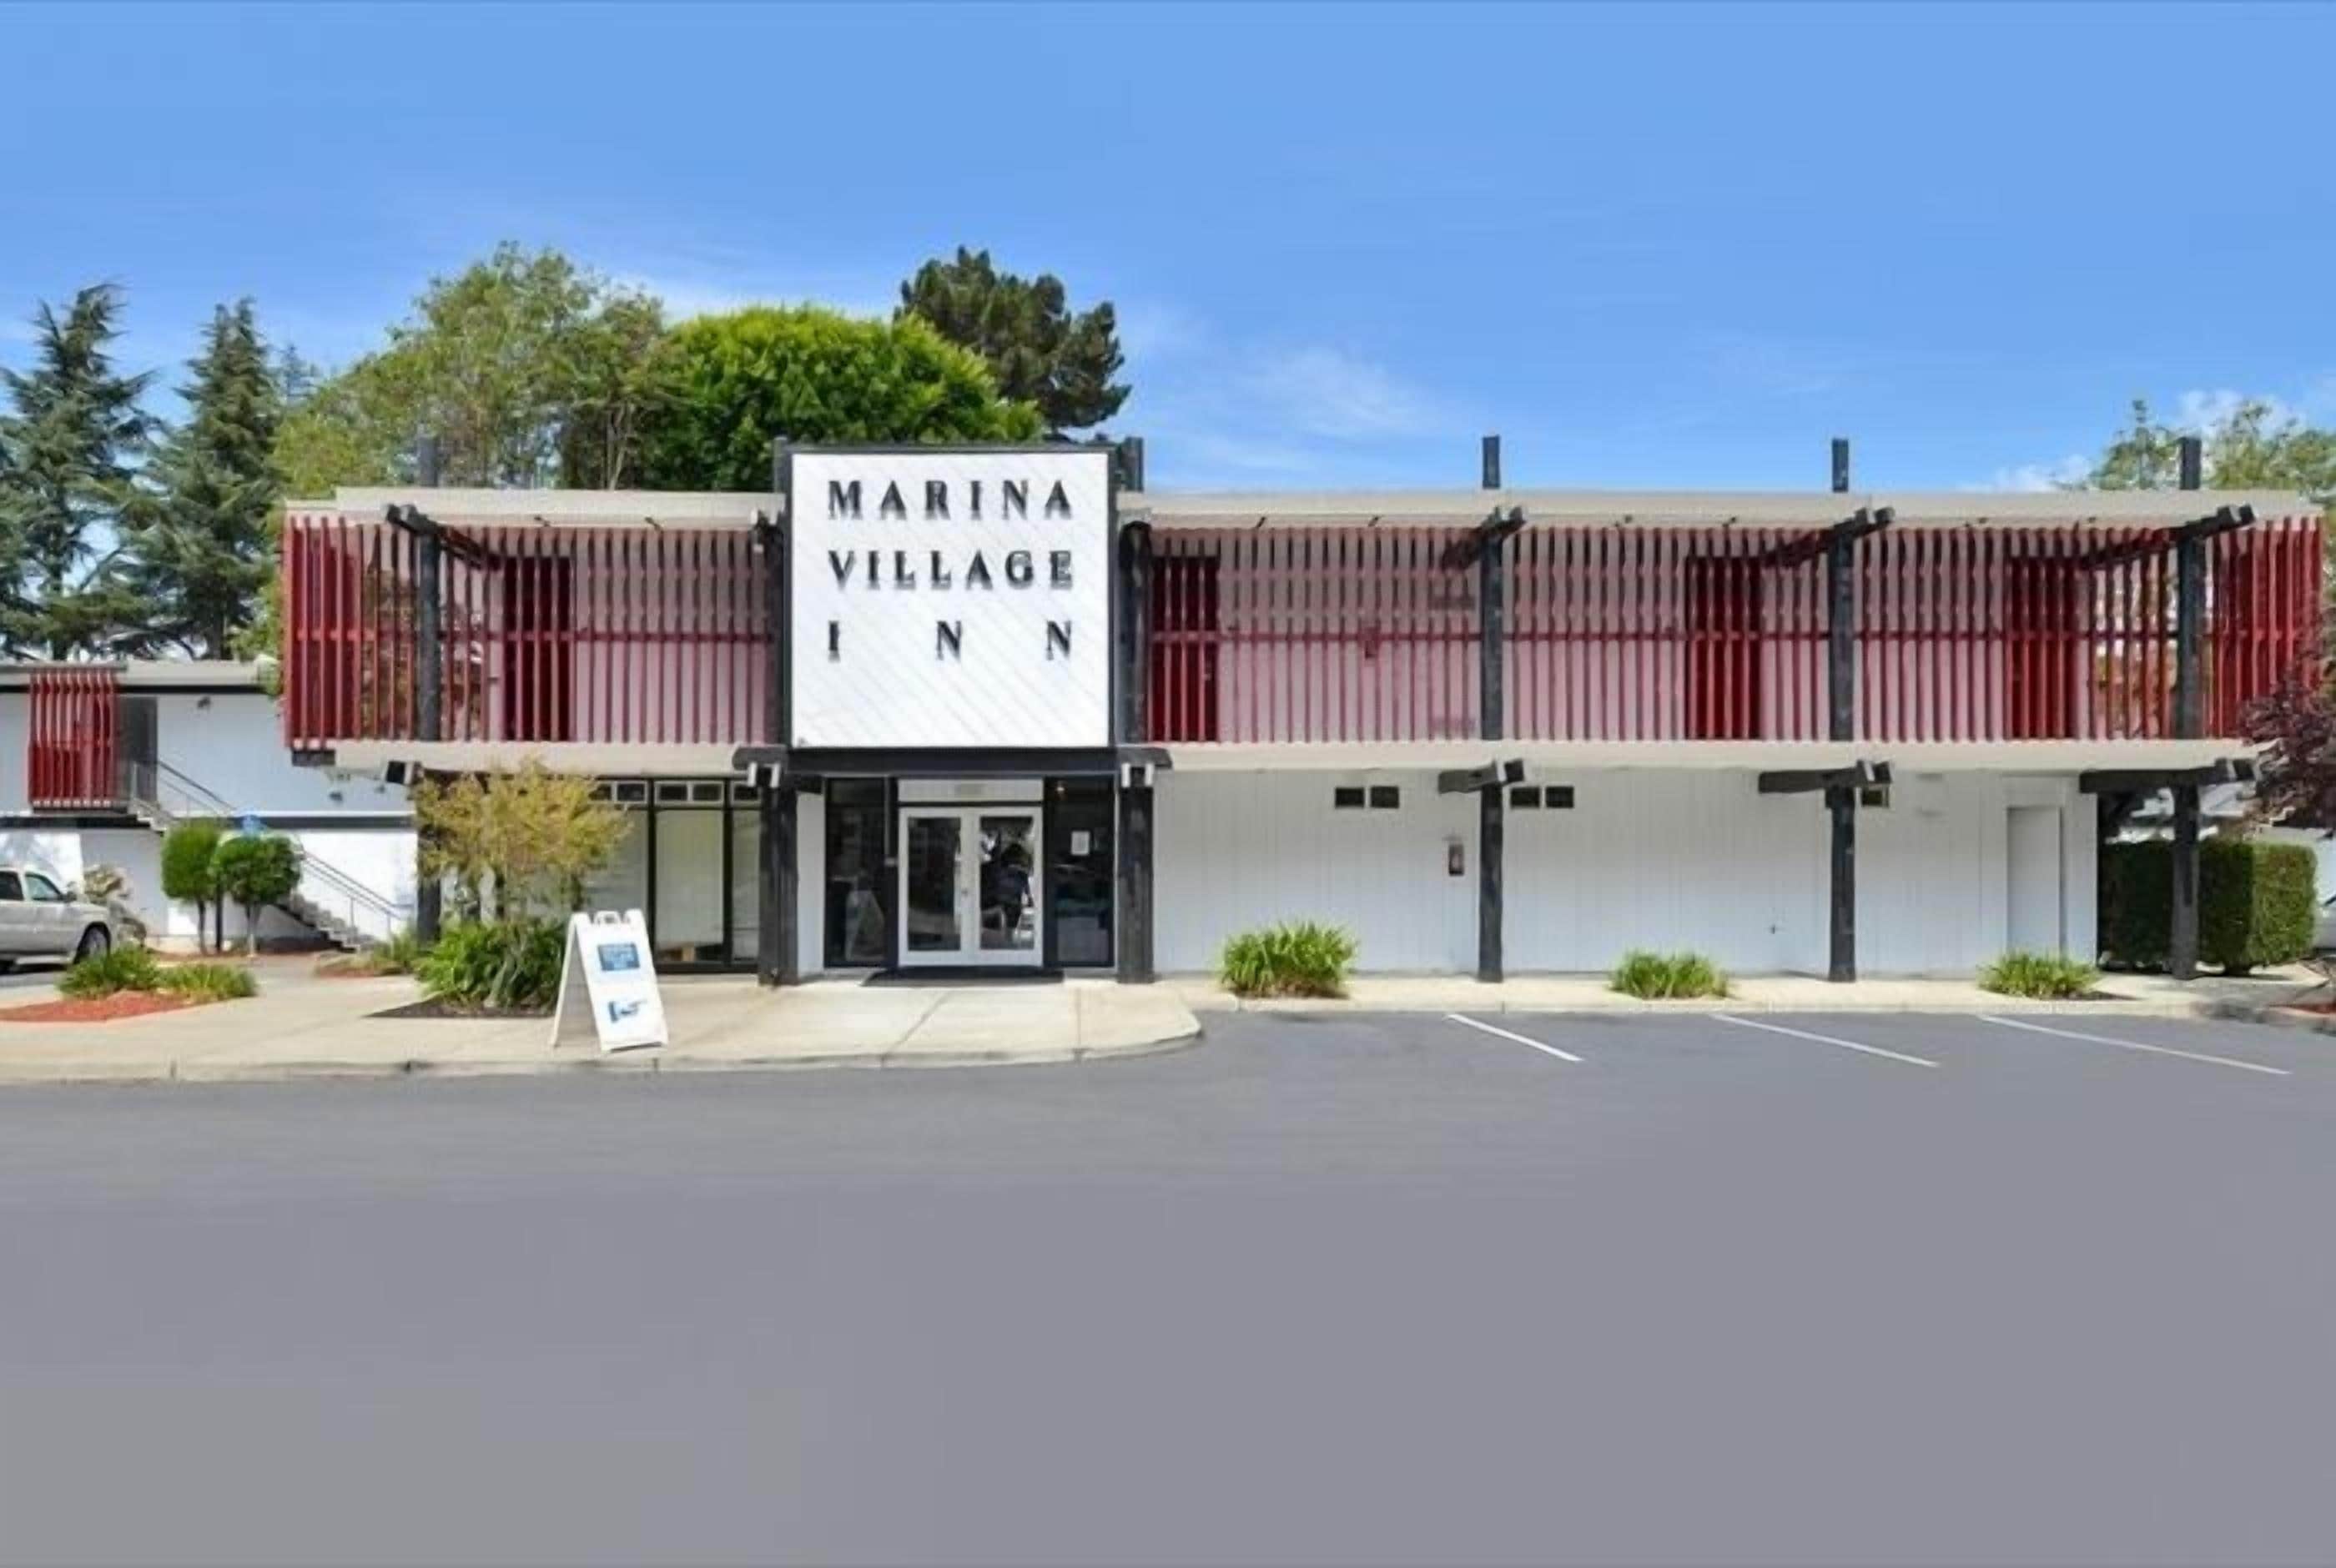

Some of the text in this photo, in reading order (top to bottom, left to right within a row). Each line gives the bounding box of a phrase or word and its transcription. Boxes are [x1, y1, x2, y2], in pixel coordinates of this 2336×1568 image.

[828, 480, 1072, 520] MARINA
[828, 550, 1073, 591] VILLAGE
[828, 620, 1072, 661] INN
